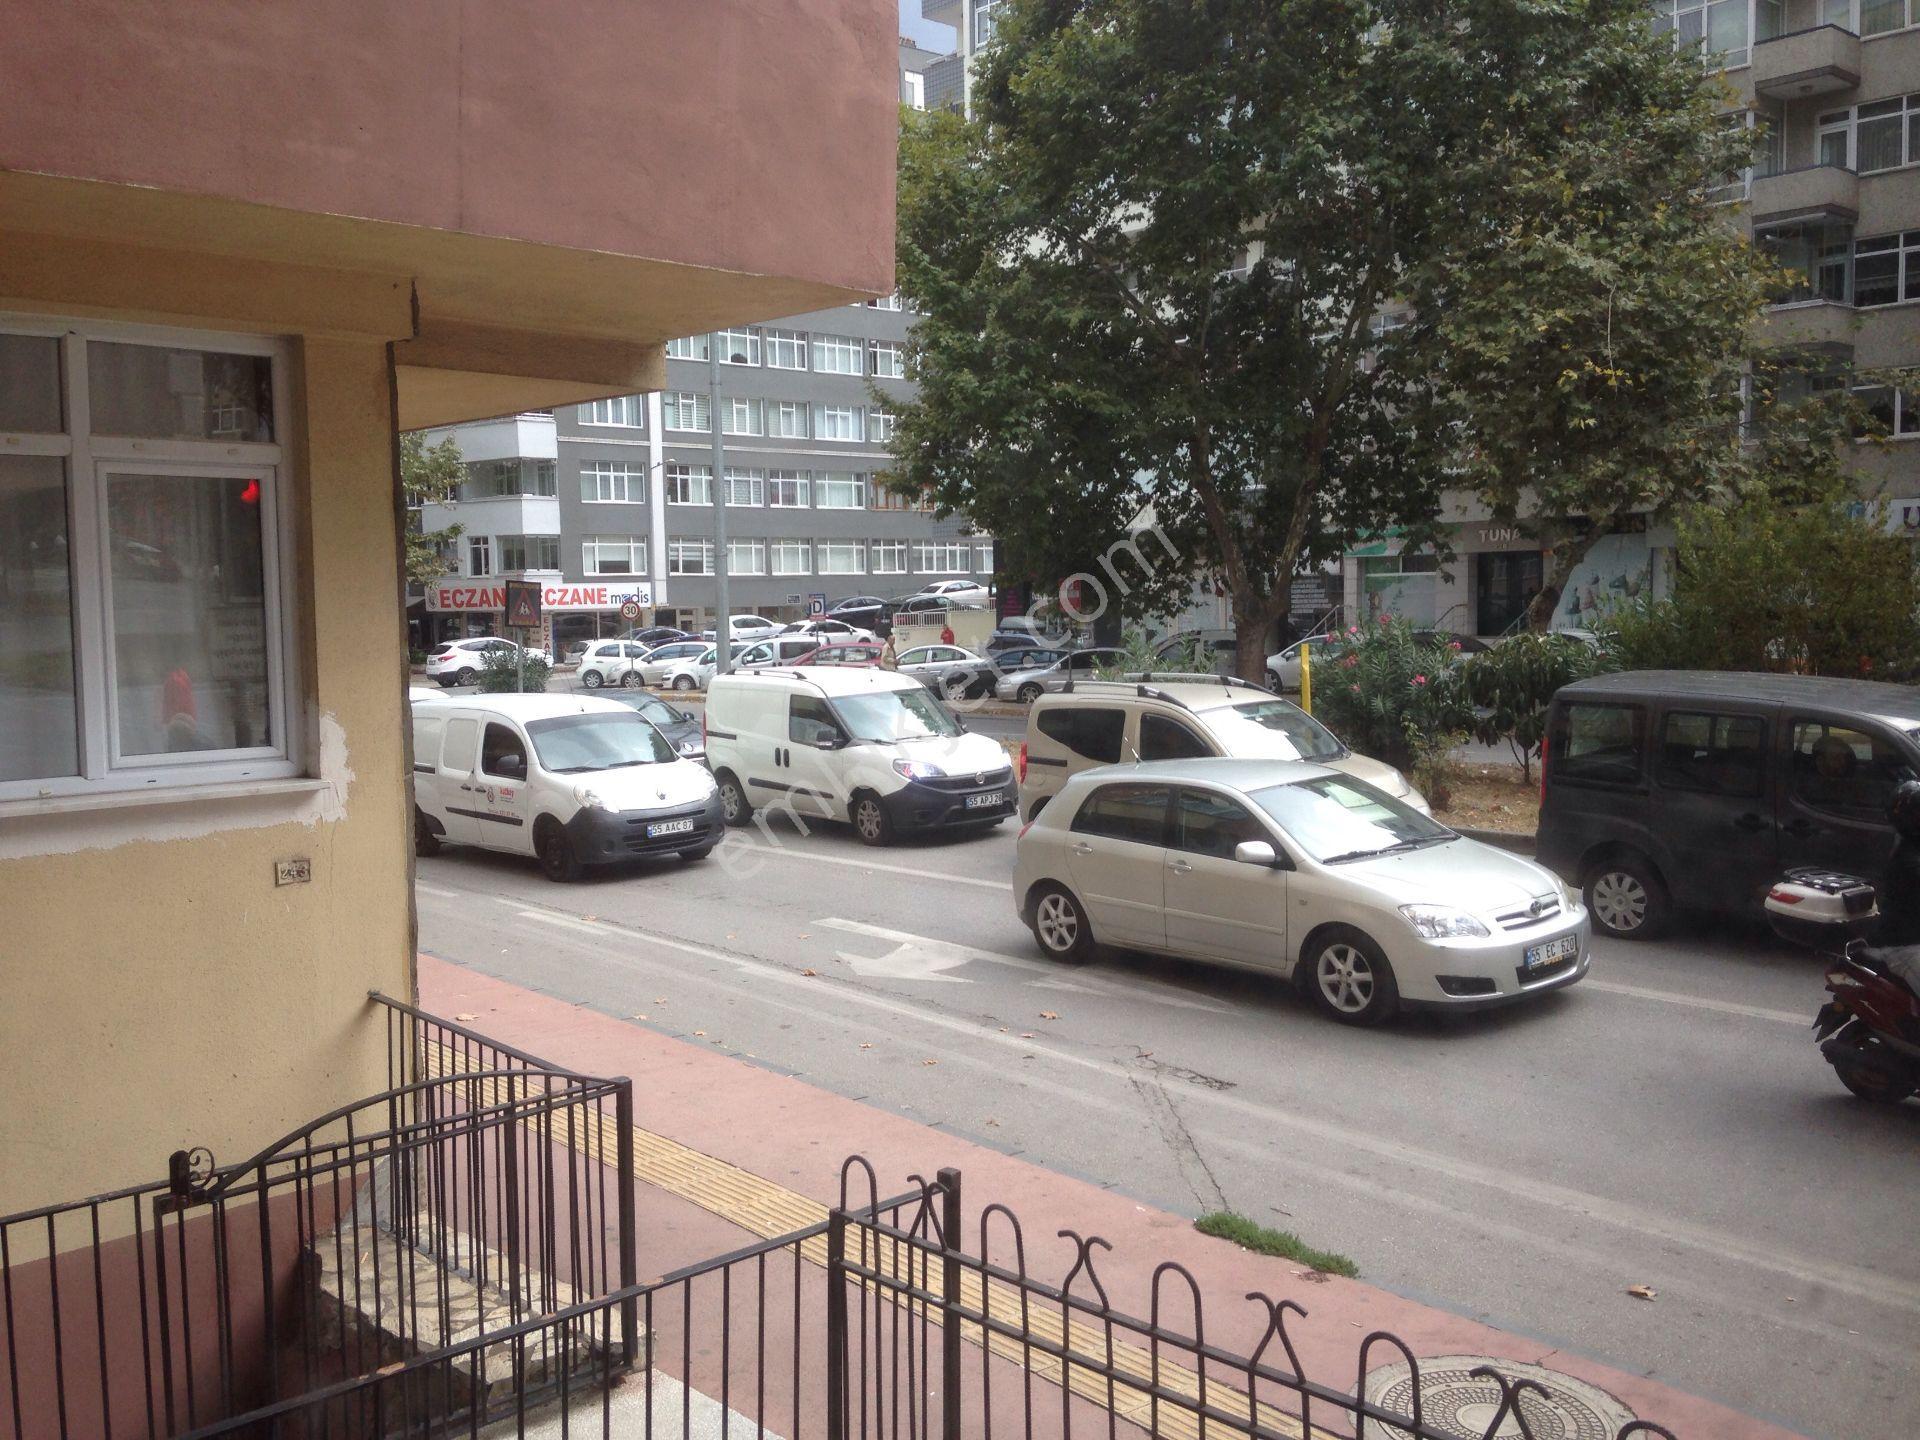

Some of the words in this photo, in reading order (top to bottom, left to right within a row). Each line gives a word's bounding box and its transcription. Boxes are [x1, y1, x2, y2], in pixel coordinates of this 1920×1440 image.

[439, 587, 506, 609] ECZAN
[541, 587, 608, 605] CZANE
[625, 605, 637, 615] 30
[813, 600, 823, 613] D
[652, 824, 662, 836] 55
[665, 823, 681, 833] AAC
[682, 820, 693, 830] 87
[1546, 943, 1556, 958] EC
